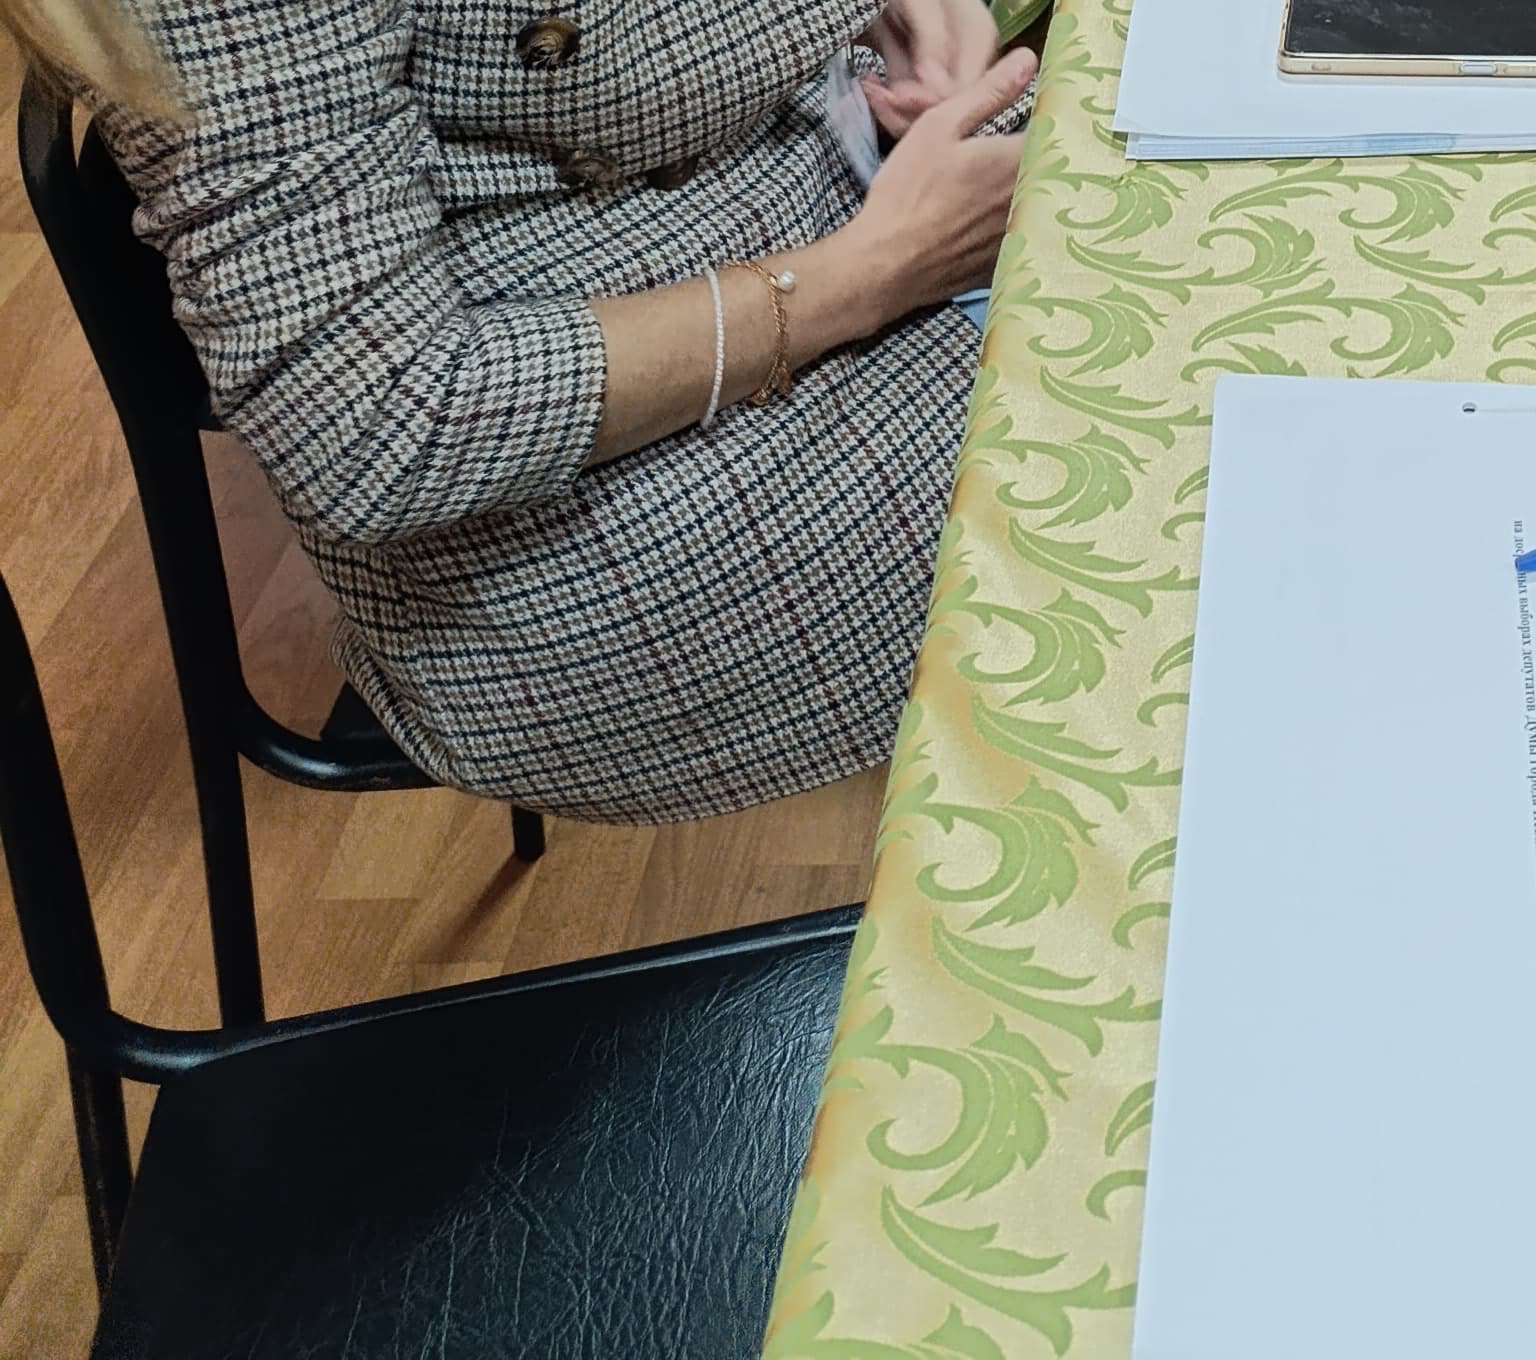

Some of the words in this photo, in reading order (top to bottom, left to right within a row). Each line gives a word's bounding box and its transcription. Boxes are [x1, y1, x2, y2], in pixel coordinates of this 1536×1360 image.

[1512, 519, 1524, 534] на
[1516, 597, 1534, 646] выборах
[1520, 649, 1536, 712] депутатов
